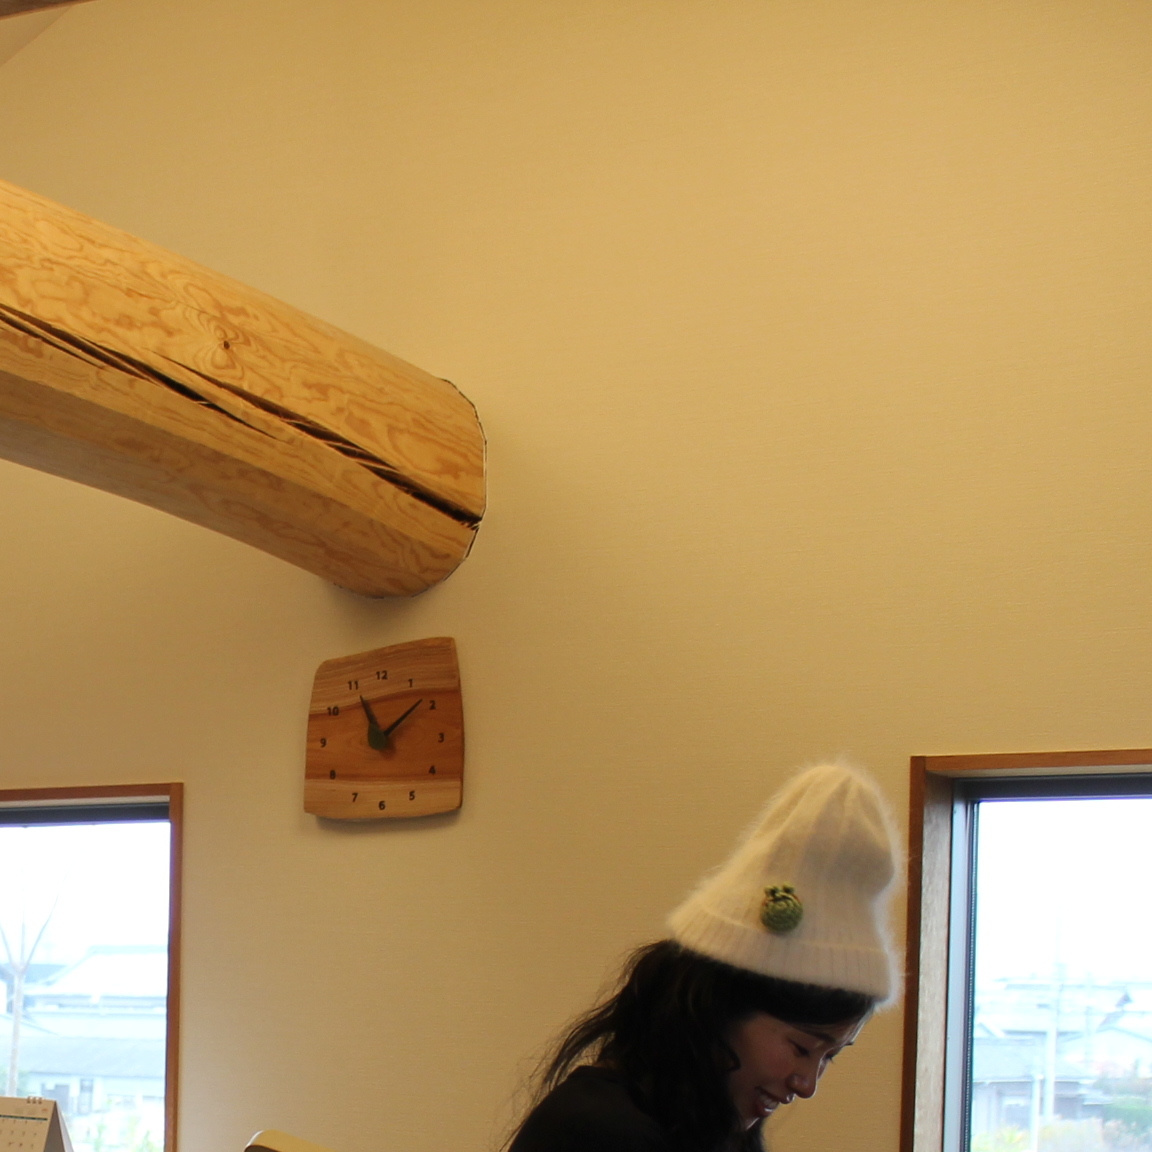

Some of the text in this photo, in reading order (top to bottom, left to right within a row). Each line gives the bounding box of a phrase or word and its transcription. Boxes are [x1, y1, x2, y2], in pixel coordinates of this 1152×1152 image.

[375, 670, 388, 681] 12
[347, 680, 359, 691] 11
[407, 678, 414, 688] 1
[428, 700, 436, 711] 2
[327, 706, 339, 717] 10
[320, 738, 327, 748] 9
[437, 733, 445, 743] 3
[329, 770, 336, 780] 8
[428, 765, 436, 775] 4
[351, 792, 358, 803] 7
[408, 790, 416, 801] 5
[378, 800, 386, 811] 6
